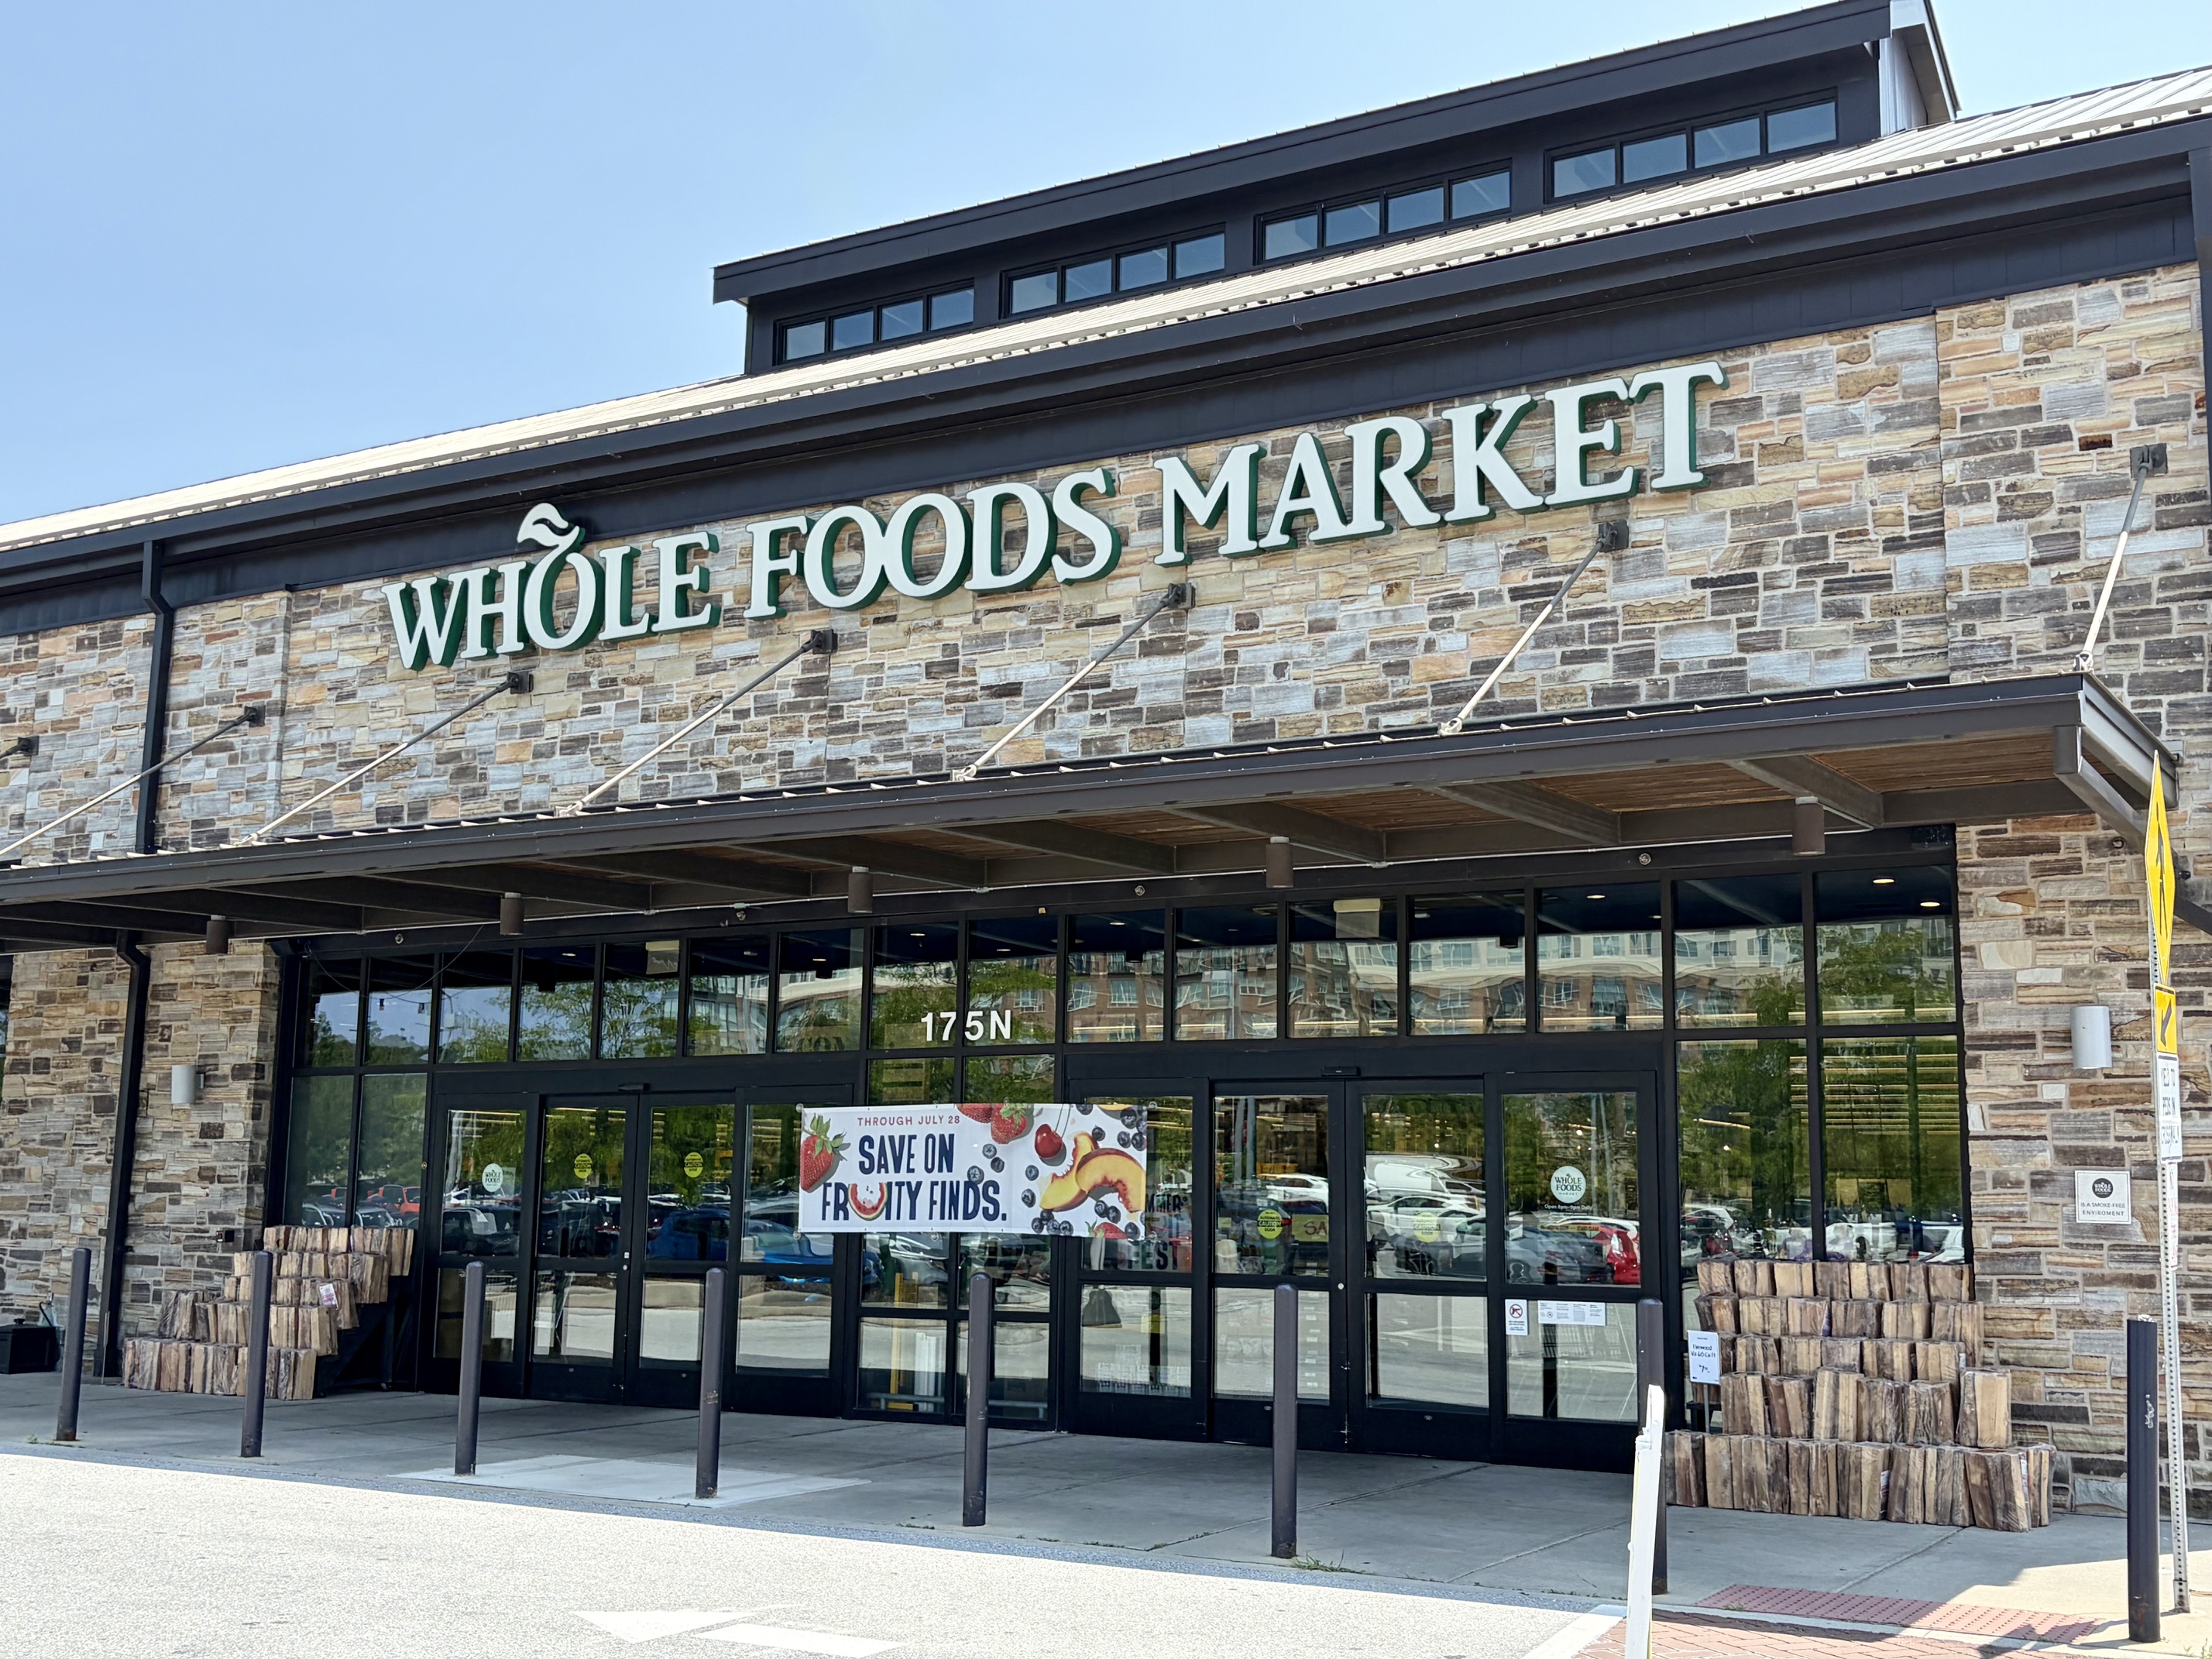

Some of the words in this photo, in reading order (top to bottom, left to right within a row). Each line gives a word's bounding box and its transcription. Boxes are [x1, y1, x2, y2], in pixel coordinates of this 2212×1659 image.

[380, 503, 720, 669] WHOLE
[744, 467, 1120, 618] FOODS
[1153, 361, 1729, 566] MARKET
[921, 1009, 1012, 1042] 175N
[857, 1116, 913, 1126] THROUGH
[918, 1115, 944, 1125] JULY
[948, 1115, 960, 1125] 28
[858, 1134, 917, 1175] SAVE
[924, 1133, 955, 1173] ON
[1554, 1175, 1582, 1184] WHOLE
[929, 1180, 1007, 1221] FINDS.
